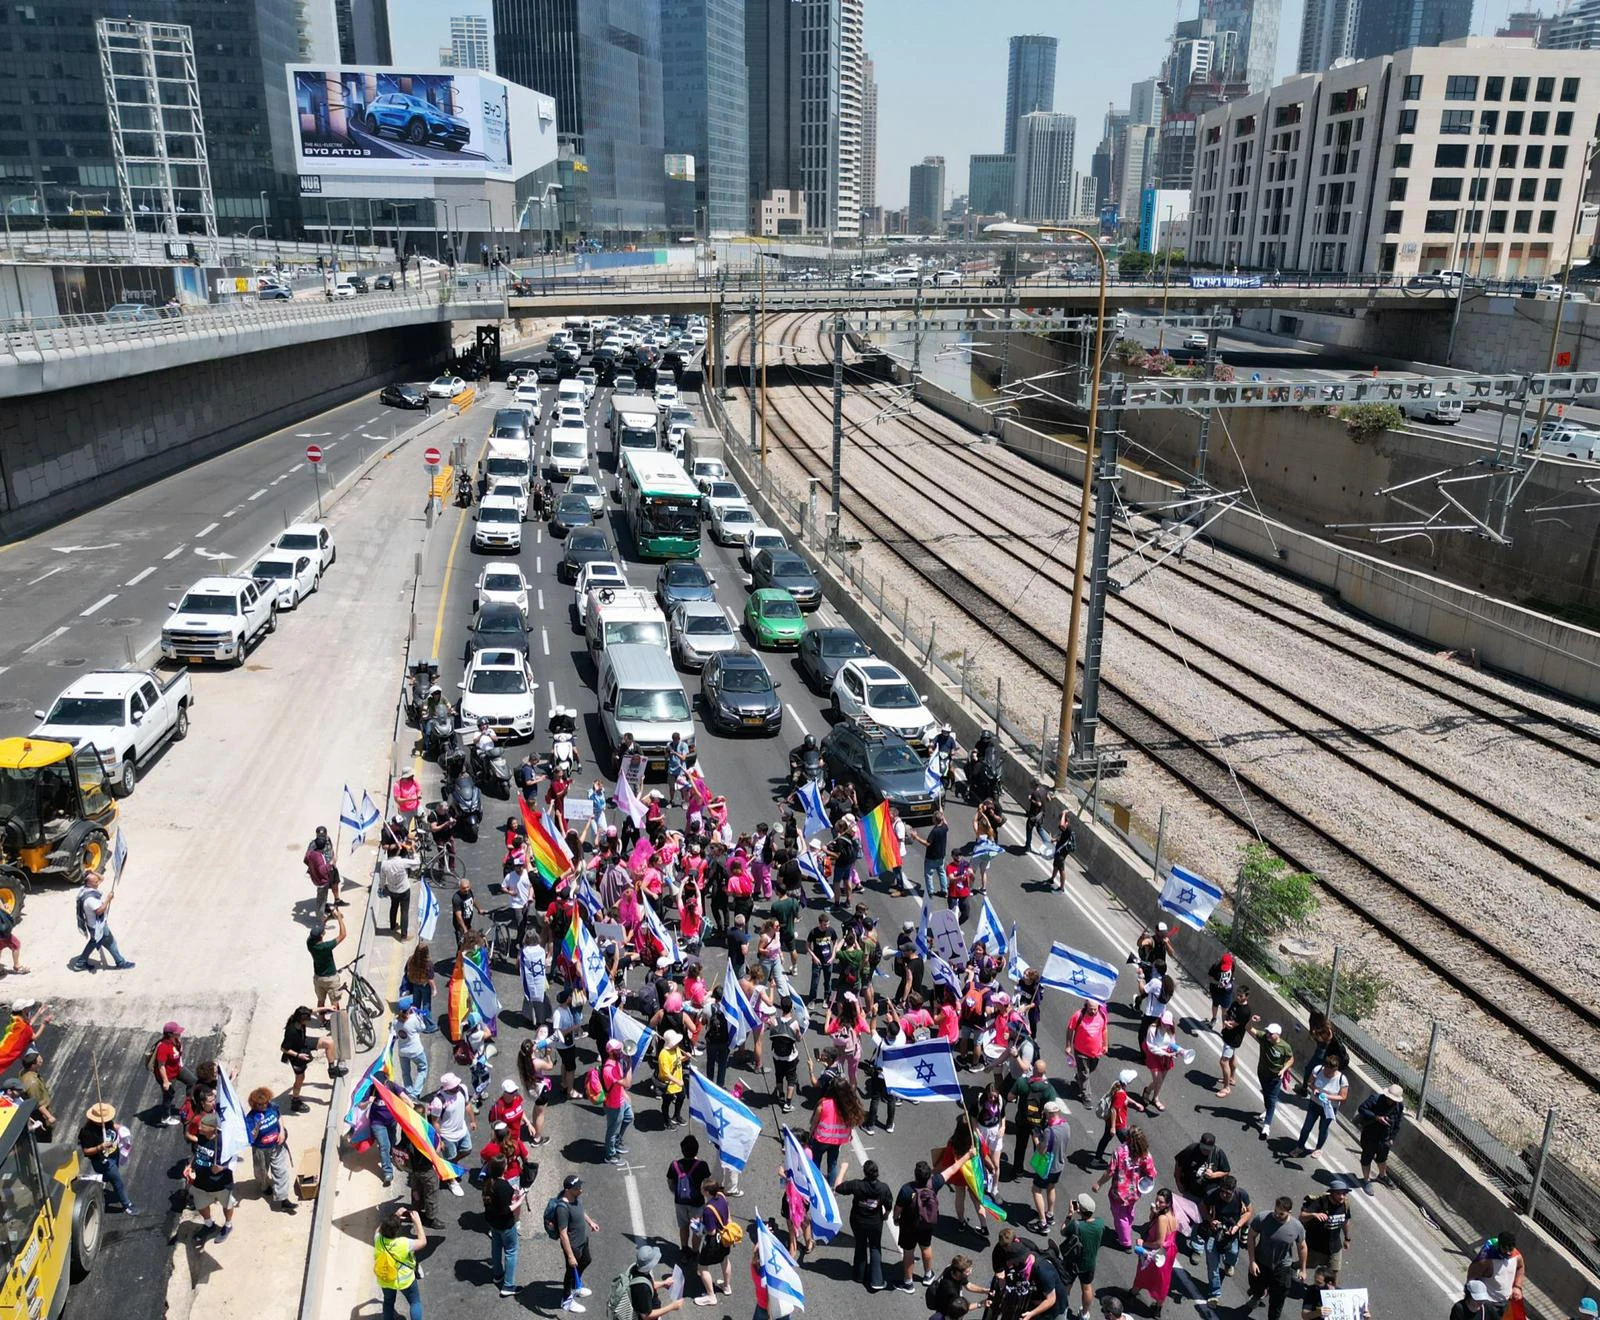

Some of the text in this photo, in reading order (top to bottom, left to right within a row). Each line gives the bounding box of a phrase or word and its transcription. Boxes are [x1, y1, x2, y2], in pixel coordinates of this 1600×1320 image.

[332, 148, 361, 156] ATTO
[301, 176, 320, 189] NUR
[170, 244, 188, 256] NUR
